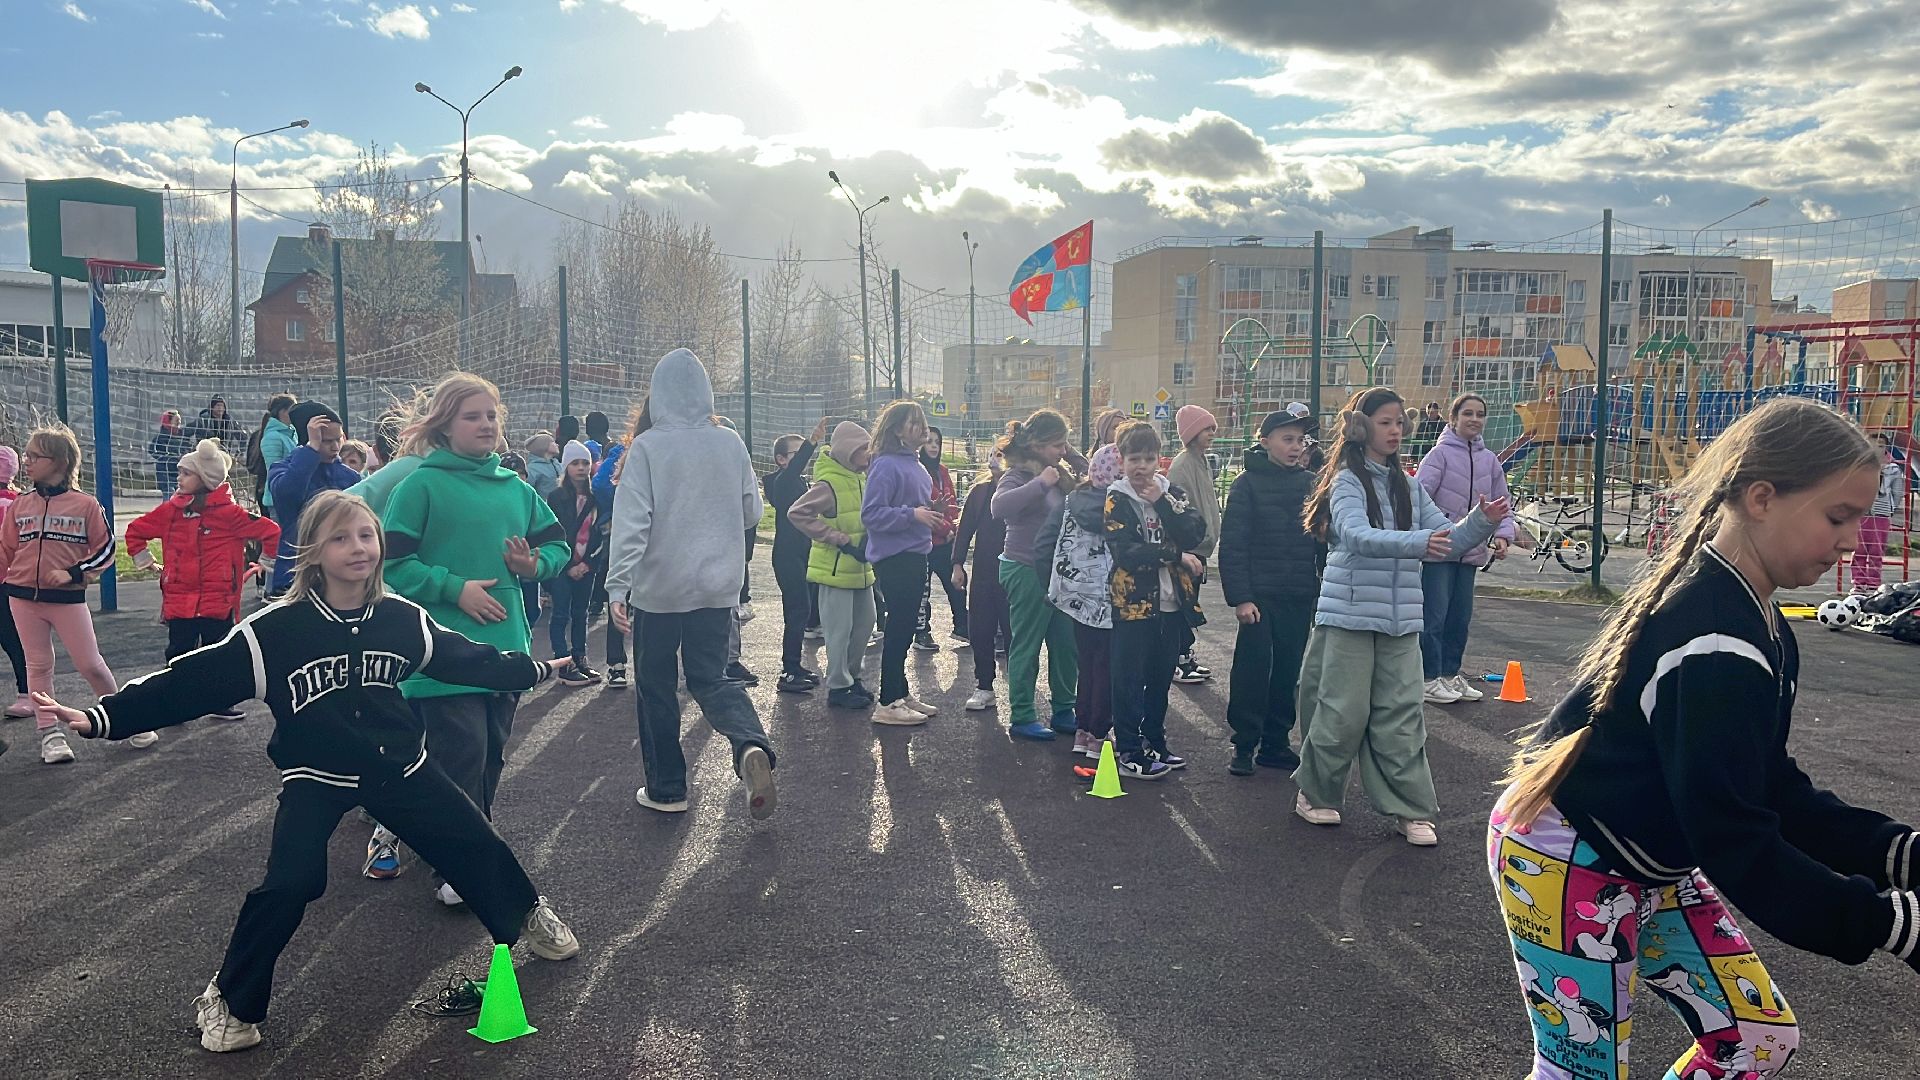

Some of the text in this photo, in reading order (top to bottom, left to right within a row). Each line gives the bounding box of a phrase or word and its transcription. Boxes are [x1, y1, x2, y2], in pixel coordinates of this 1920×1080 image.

[1506, 909, 1551, 936] positive
[1512, 924, 1543, 943] vibes
[1545, 1031, 1607, 1060] sylvester
[1556, 1044, 1579, 1059] and
